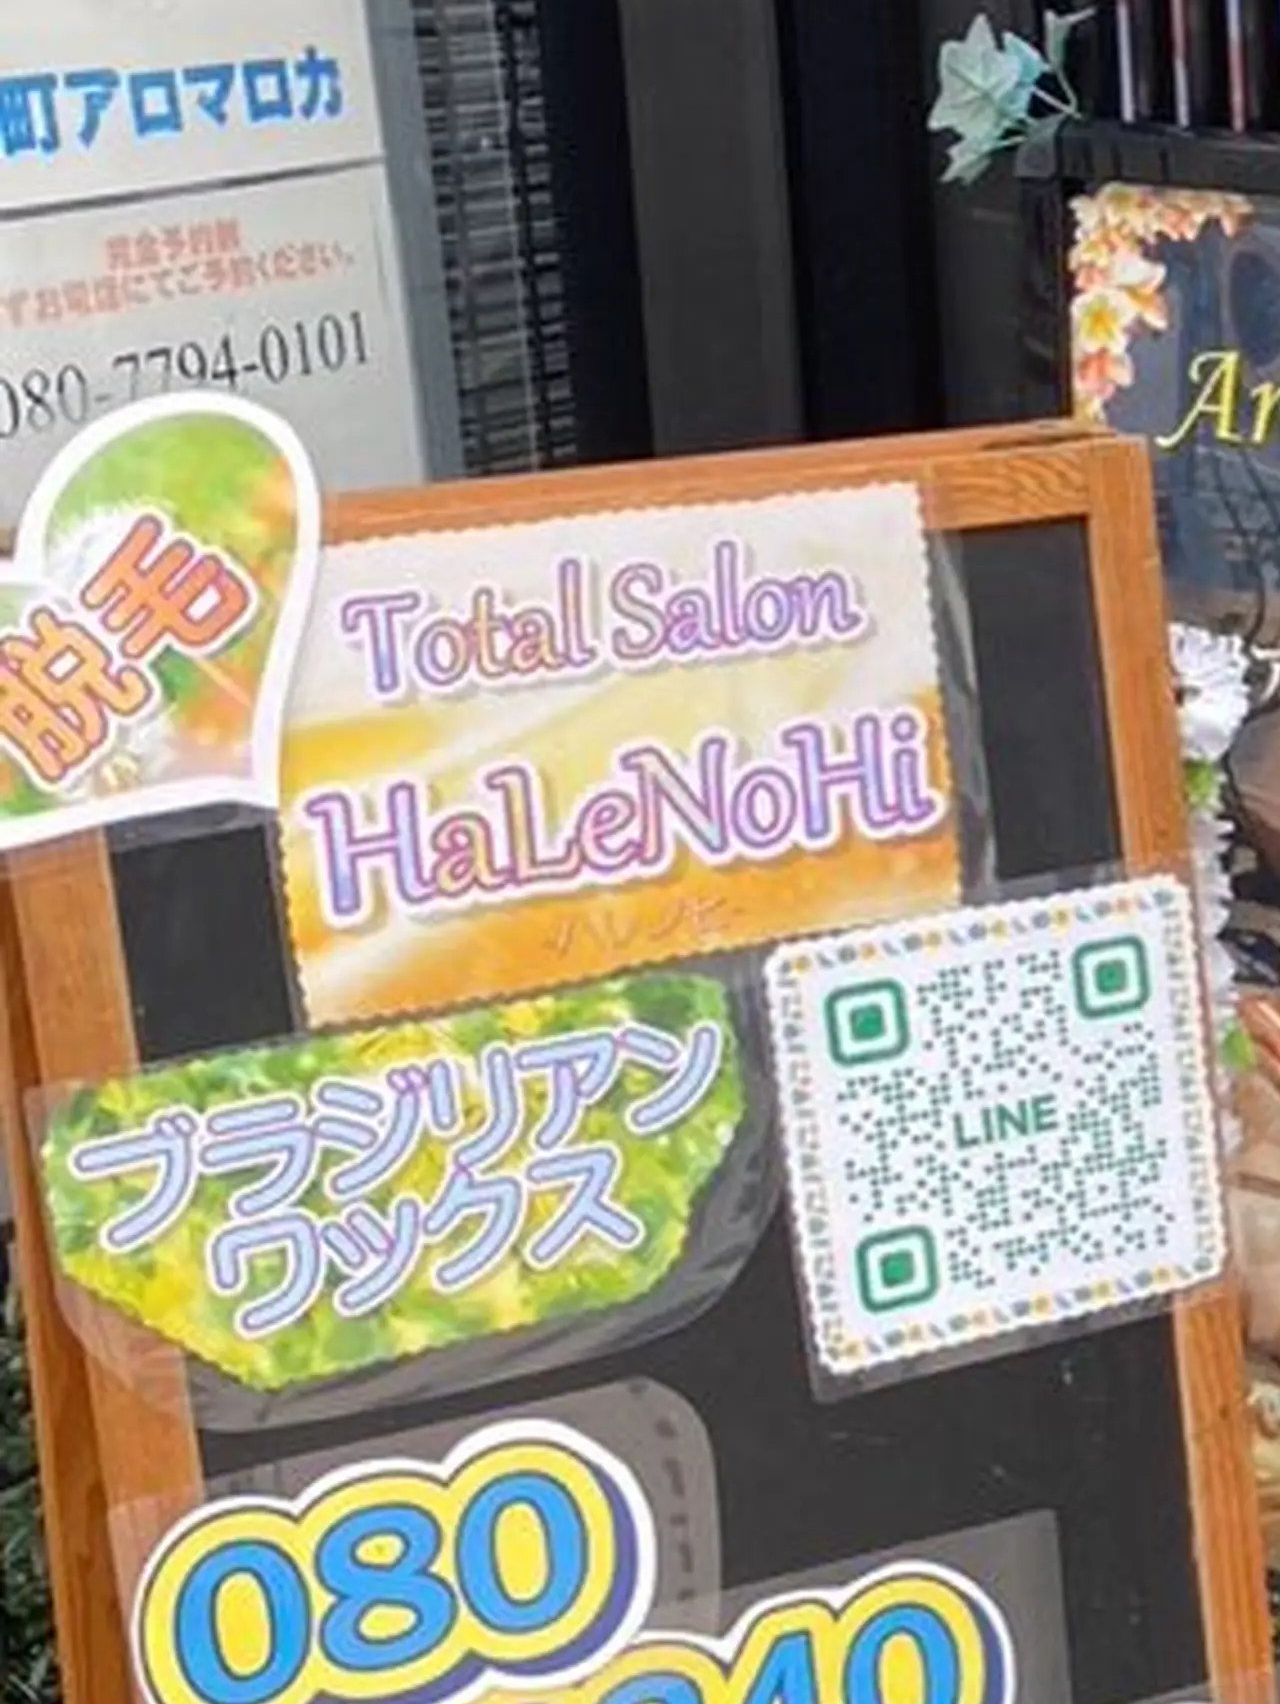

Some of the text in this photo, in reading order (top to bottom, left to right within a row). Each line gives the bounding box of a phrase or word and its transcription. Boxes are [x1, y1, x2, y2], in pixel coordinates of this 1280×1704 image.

[0, 309, 366, 438] 080-7794-0101
[0, 514, 250, 781] 脱毛
[342, 541, 861, 695] Total Salon
[305, 711, 935, 917] HaLeNoHi
[75, 1022, 723, 1250] ブラジリアン
[951, 1093, 1061, 1153] LINE
[211, 1143, 643, 1333] ワックス
